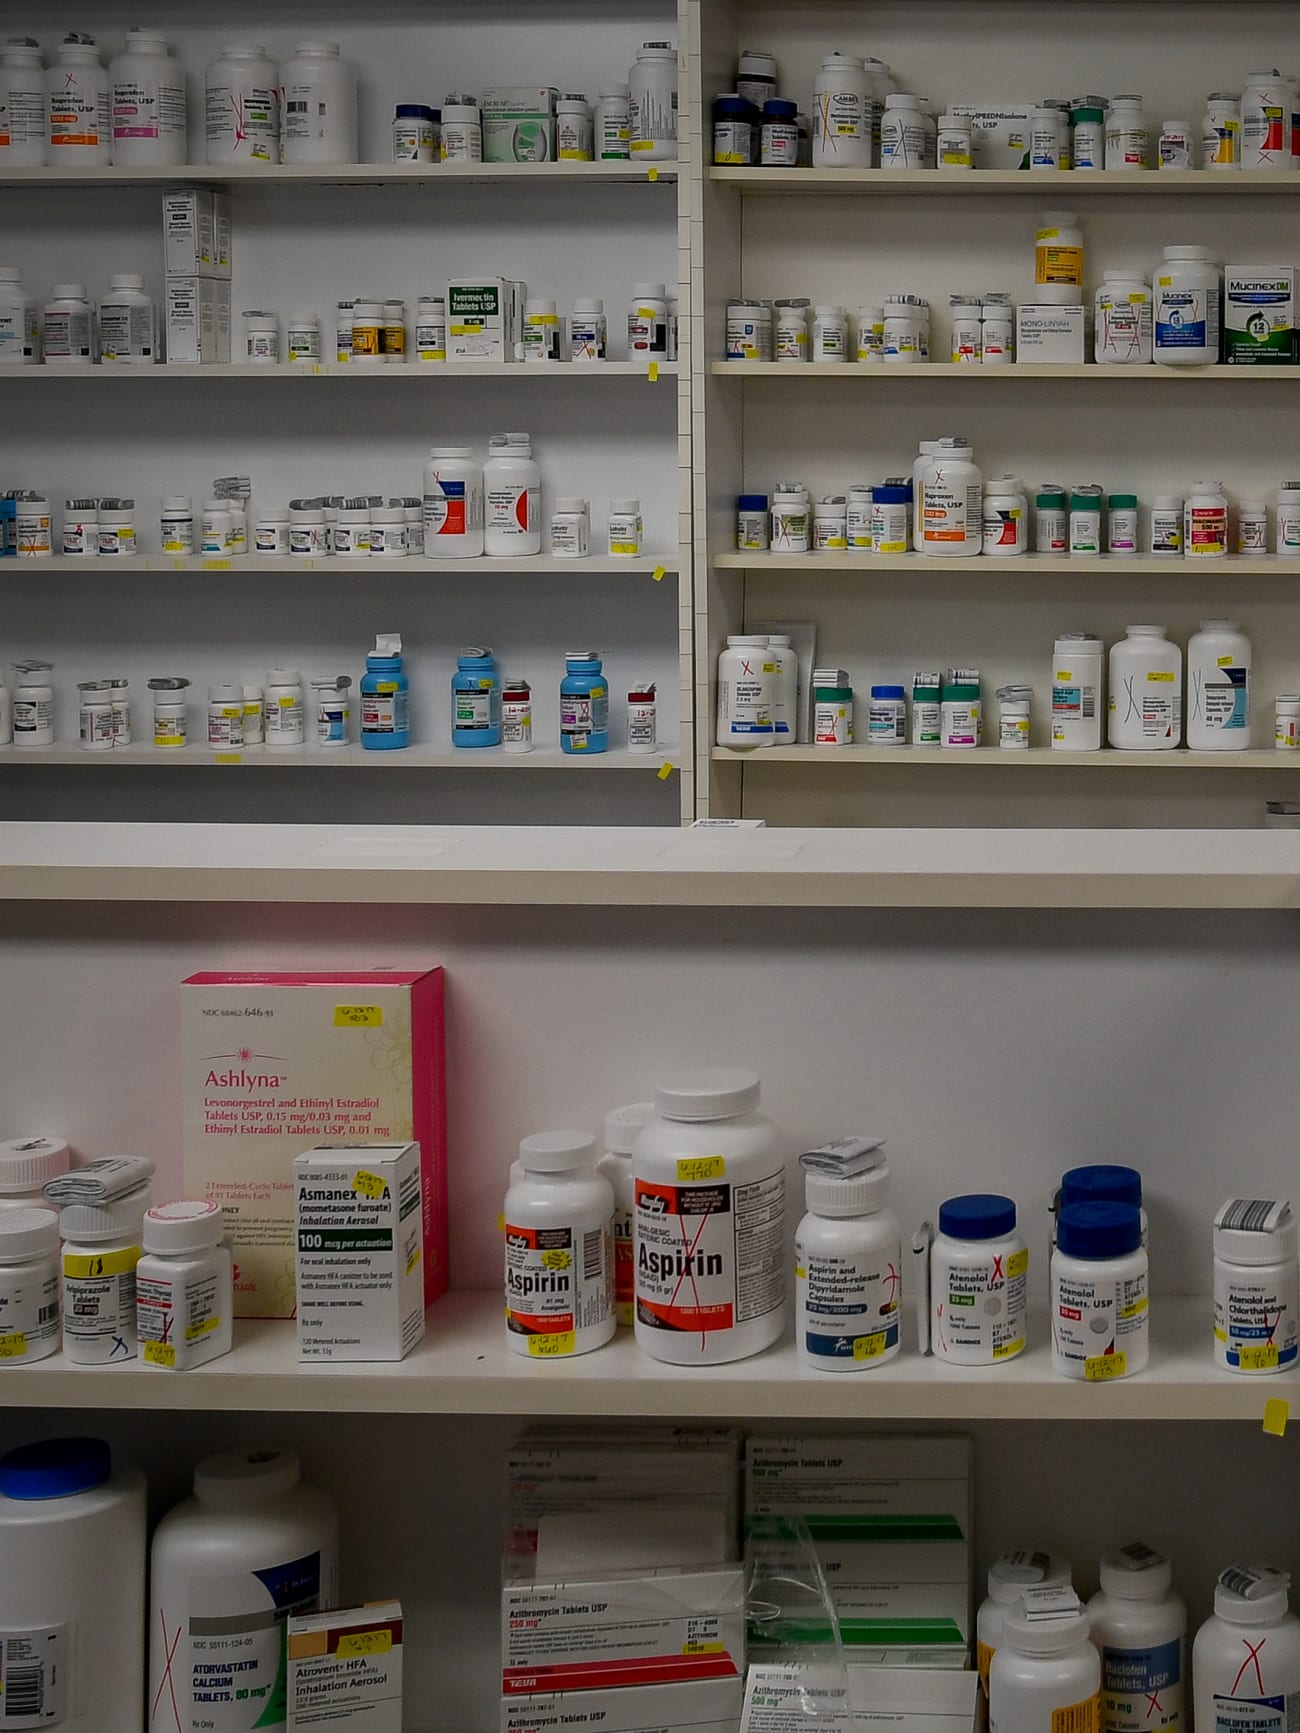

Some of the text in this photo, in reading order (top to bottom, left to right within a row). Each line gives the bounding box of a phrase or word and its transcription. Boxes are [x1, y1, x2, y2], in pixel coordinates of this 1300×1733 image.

[454, 292, 494, 303] Ivermectin
[452, 302, 496, 311] Tablets USP
[1253, 323, 1265, 331] 12
[204, 1098, 380, 1111] Levonorgestrel and Ethinyl Estradiol
[204, 1111, 372, 1124] Tablets USP, 0.15 mg/0.03 mg and
[204, 1125, 391, 1138] Ethinyl Estradiol Tablets USP, 0.01 mg
[299, 1187, 358, 1201] Asmanex
[299, 1202, 391, 1214] (mometasone furoate)
[299, 1215, 379, 1225] Inhalation Aerosol
[299, 1235, 392, 1250] 100 mcg per actuation
[300, 1257, 310, 1265] For
[324, 1257, 356, 1265] inhalation
[358, 1257, 371, 1267] only
[639, 1242, 723, 1281] Aspirin
[808, 1264, 856, 1276] Aspirin and
[507, 1267, 570, 1297] Aspirin
[808, 1273, 880, 1285] Extended-release
[949, 1273, 988, 1284] Atenolol
[66, 1285, 111, 1296] Aripiprazole
[808, 1282, 865, 1295] Dipyridamole
[949, 1281, 1006, 1294] Tablets, USP
[1059, 1286, 1095, 1299] Atenolol
[808, 1292, 844, 1305] Capsules
[961, 1297, 973, 1306] mg
[1059, 1296, 1113, 1308] Tablets, USP
[1229, 1294, 1277, 1305] Atenolol and
[1229, 1304, 1287, 1316] Chlorthalidone
[753, 1458, 843, 1470] Azithromycin Tablets USP
[826, 1562, 842, 1572] USP
[509, 1603, 608, 1621] Azithromycin Tablets USP
[509, 1620, 524, 1629] 250
[193, 1638, 253, 1650] NDC 55111-124-05
[193, 1659, 259, 1675] ATORVASTATIN
[346, 1658, 367, 1671] HFA
[1105, 1663, 1148, 1676] Baclofen
[193, 1677, 233, 1689] CALCIUM
[296, 1674, 388, 1697] Inhalation Aerosol
[1105, 1673, 1169, 1690] Tablets, USP
[193, 1690, 234, 1703] TABLETS,
[752, 1685, 800, 1699] Azithromycin
[830, 1687, 846, 1698] USP
[751, 1697, 765, 1707] 500
[1105, 1700, 1132, 1715] 10 mg
[192, 1719, 214, 1729] Rx Only
[508, 1711, 606, 1730] Azithromycin Tablets USP
[1215, 1716, 1283, 1729] BACLOFEN TABLETS
